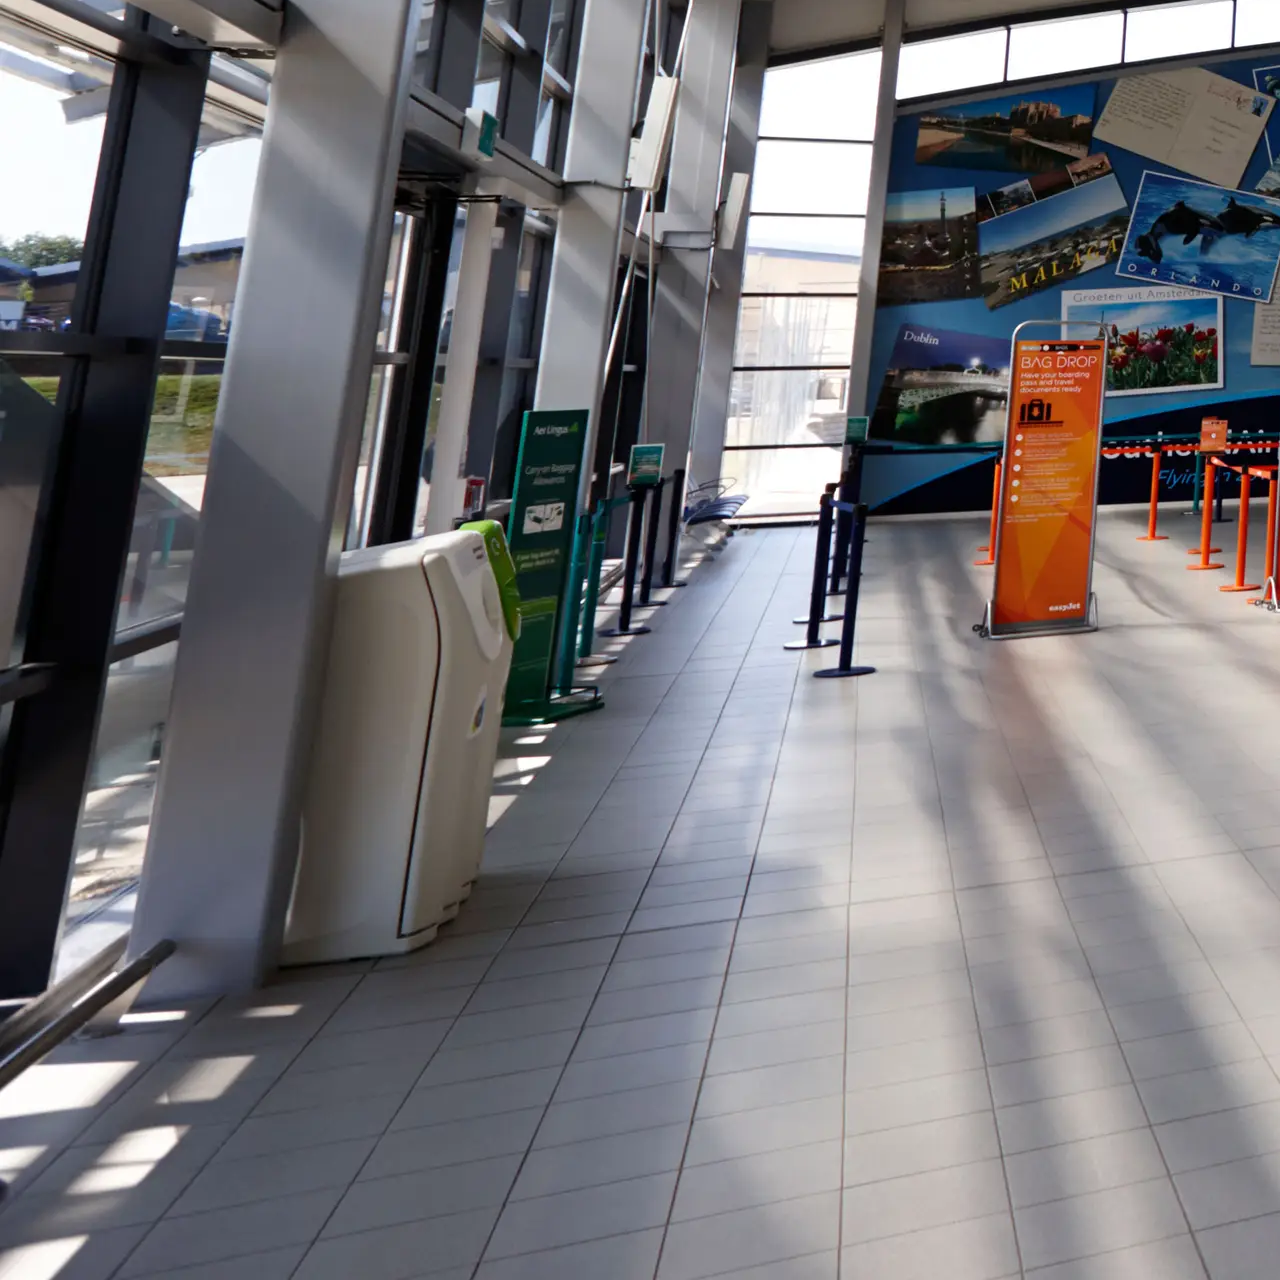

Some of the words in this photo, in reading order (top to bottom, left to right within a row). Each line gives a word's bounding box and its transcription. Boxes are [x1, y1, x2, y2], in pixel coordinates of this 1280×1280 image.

[1009, 238, 1118, 294] MALAGA
[1127, 263, 1262, 296] ORLANDO
[1073, 292, 1122, 303] Groeten
[1127, 291, 1142, 300] uit
[904, 330, 939, 345] Dublin
[1021, 356, 1052, 368] BAG
[1056, 355, 1097, 368] DROP
[1058, 371, 1090, 379] boarding
[1062, 385, 1081, 393] ready
[533, 426, 546, 435] Aer
[547, 425, 569, 437] Lingus
[1048, 601, 1081, 611] easyJet
